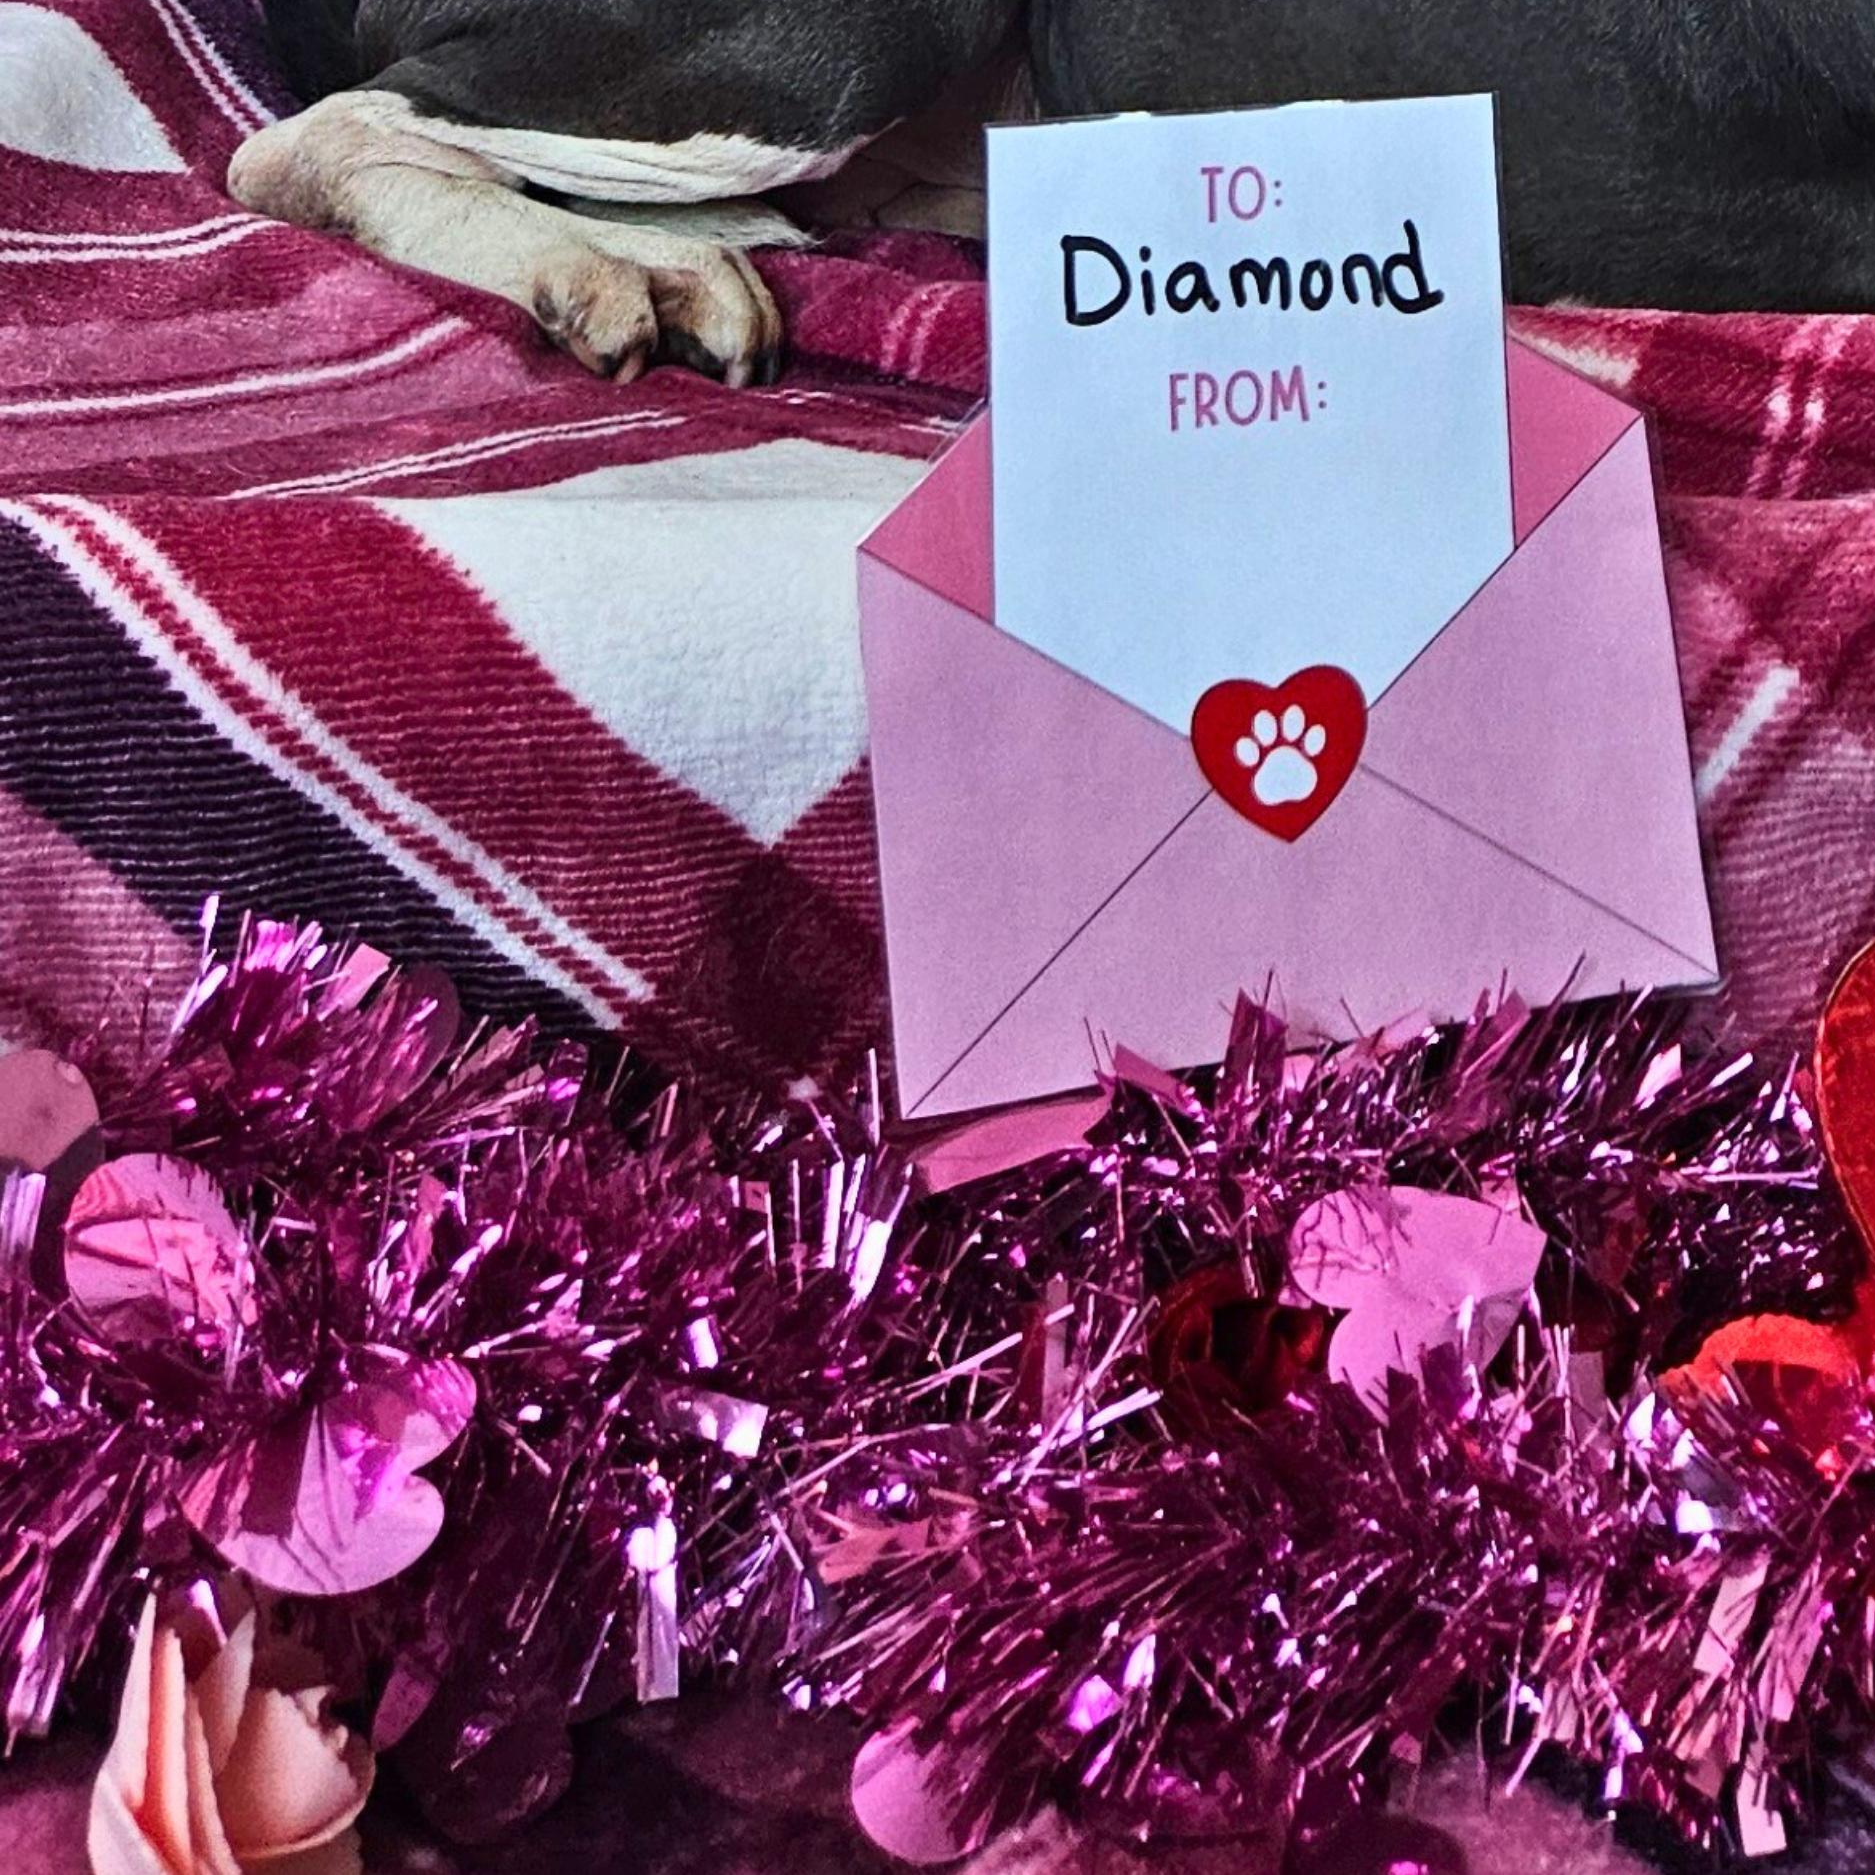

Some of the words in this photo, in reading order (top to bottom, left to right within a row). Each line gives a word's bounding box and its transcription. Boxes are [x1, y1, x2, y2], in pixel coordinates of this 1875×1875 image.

[1200, 164, 1284, 224] TO:
[1060, 219, 1445, 327] Diamond
[1168, 364, 1328, 432] FROM:
